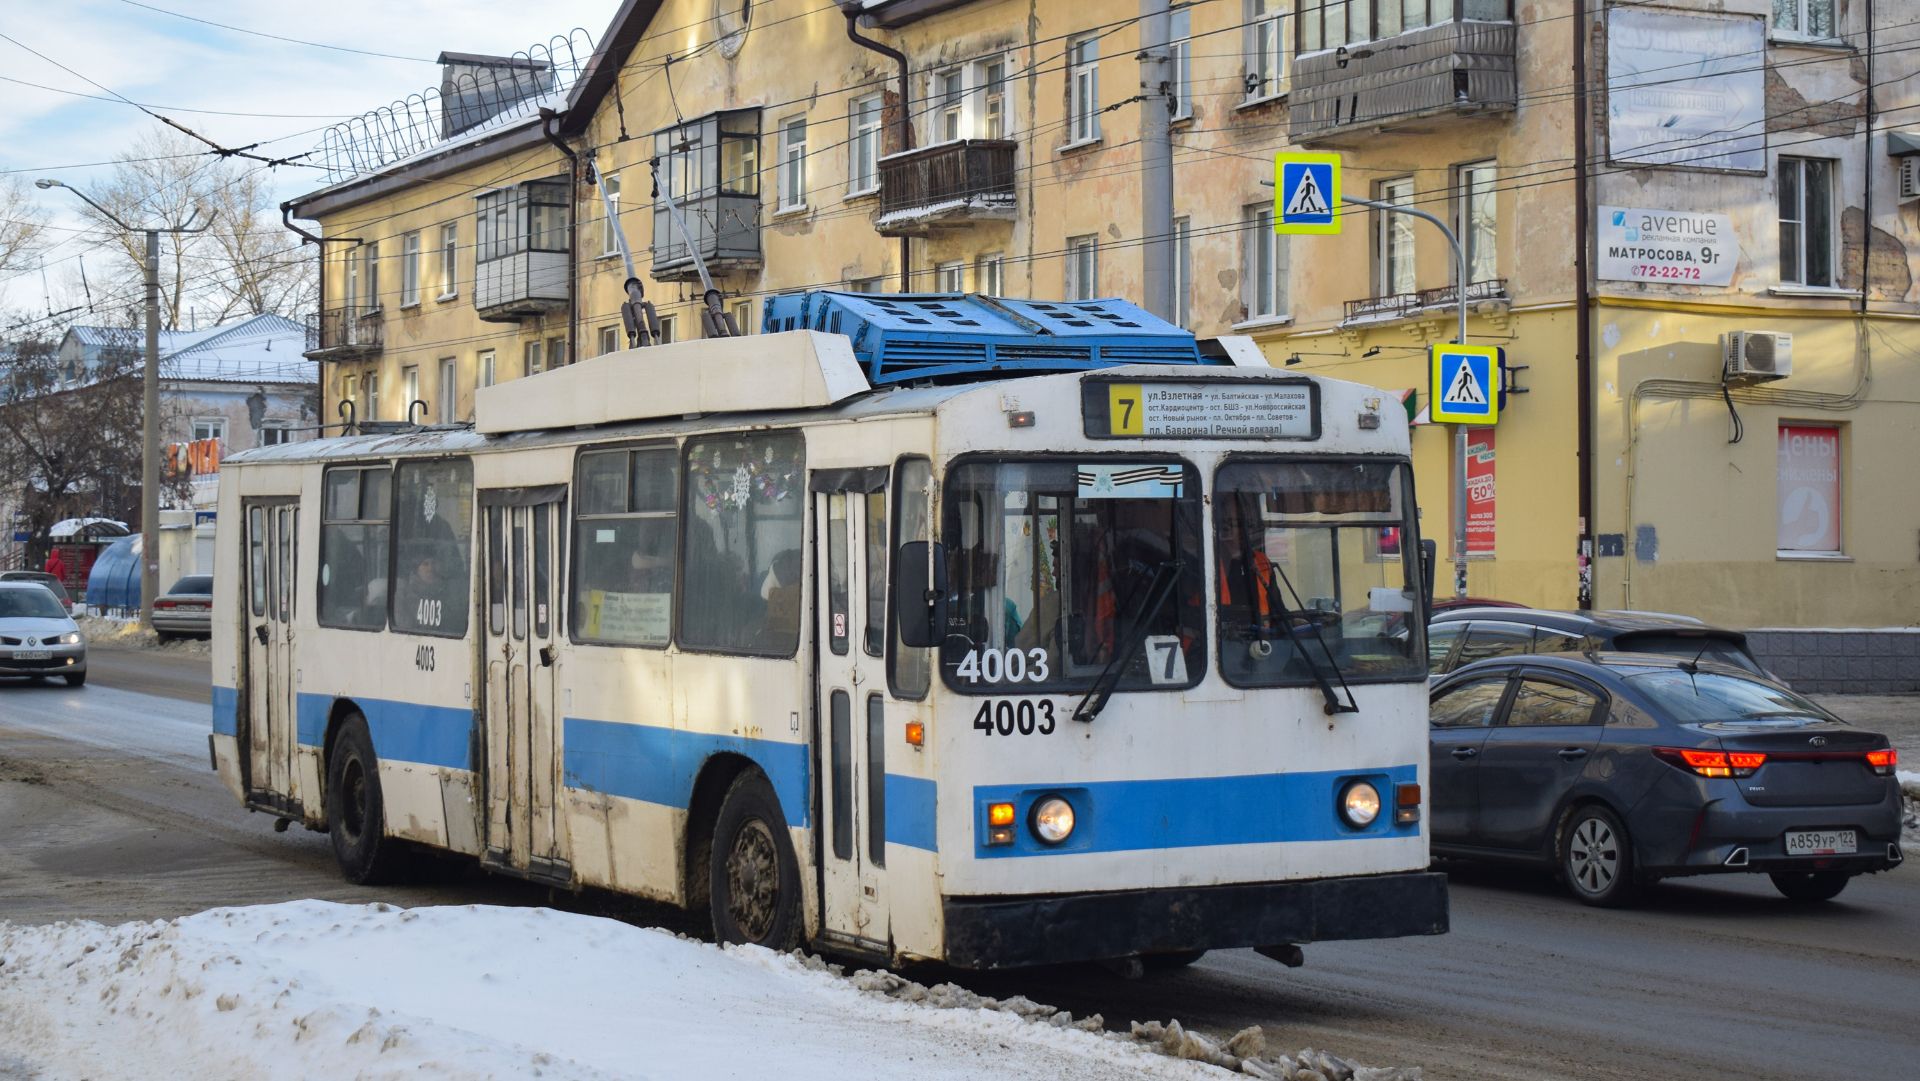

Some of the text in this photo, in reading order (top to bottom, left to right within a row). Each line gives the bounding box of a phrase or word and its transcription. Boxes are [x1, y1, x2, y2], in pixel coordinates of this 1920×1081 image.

[1641, 215, 1717, 236] avenue
[1641, 234, 1717, 245] рекламная компания
[1609, 246, 1697, 264] МАТРОСОВА,
[1640, 265, 1701, 279] 72-22-72
[1222, 392, 1260, 400] Балтийская
[1118, 398, 1134, 429] 7
[1224, 403, 1239, 411] БШЗ
[1163, 413, 1185, 422] Новый
[1187, 415, 1207, 423] рынок
[1224, 413, 1250, 422] Октября
[1267, 413, 1293, 421] Советов
[417, 598, 442, 627] 4003
[415, 644, 435, 672] 4003
[956, 647, 1049, 683] 4003
[1153, 641, 1178, 679] 7
[973, 699, 1056, 736] 4003
[1813, 738, 1826, 746] KIA
[1838, 831, 1854, 844] 122
